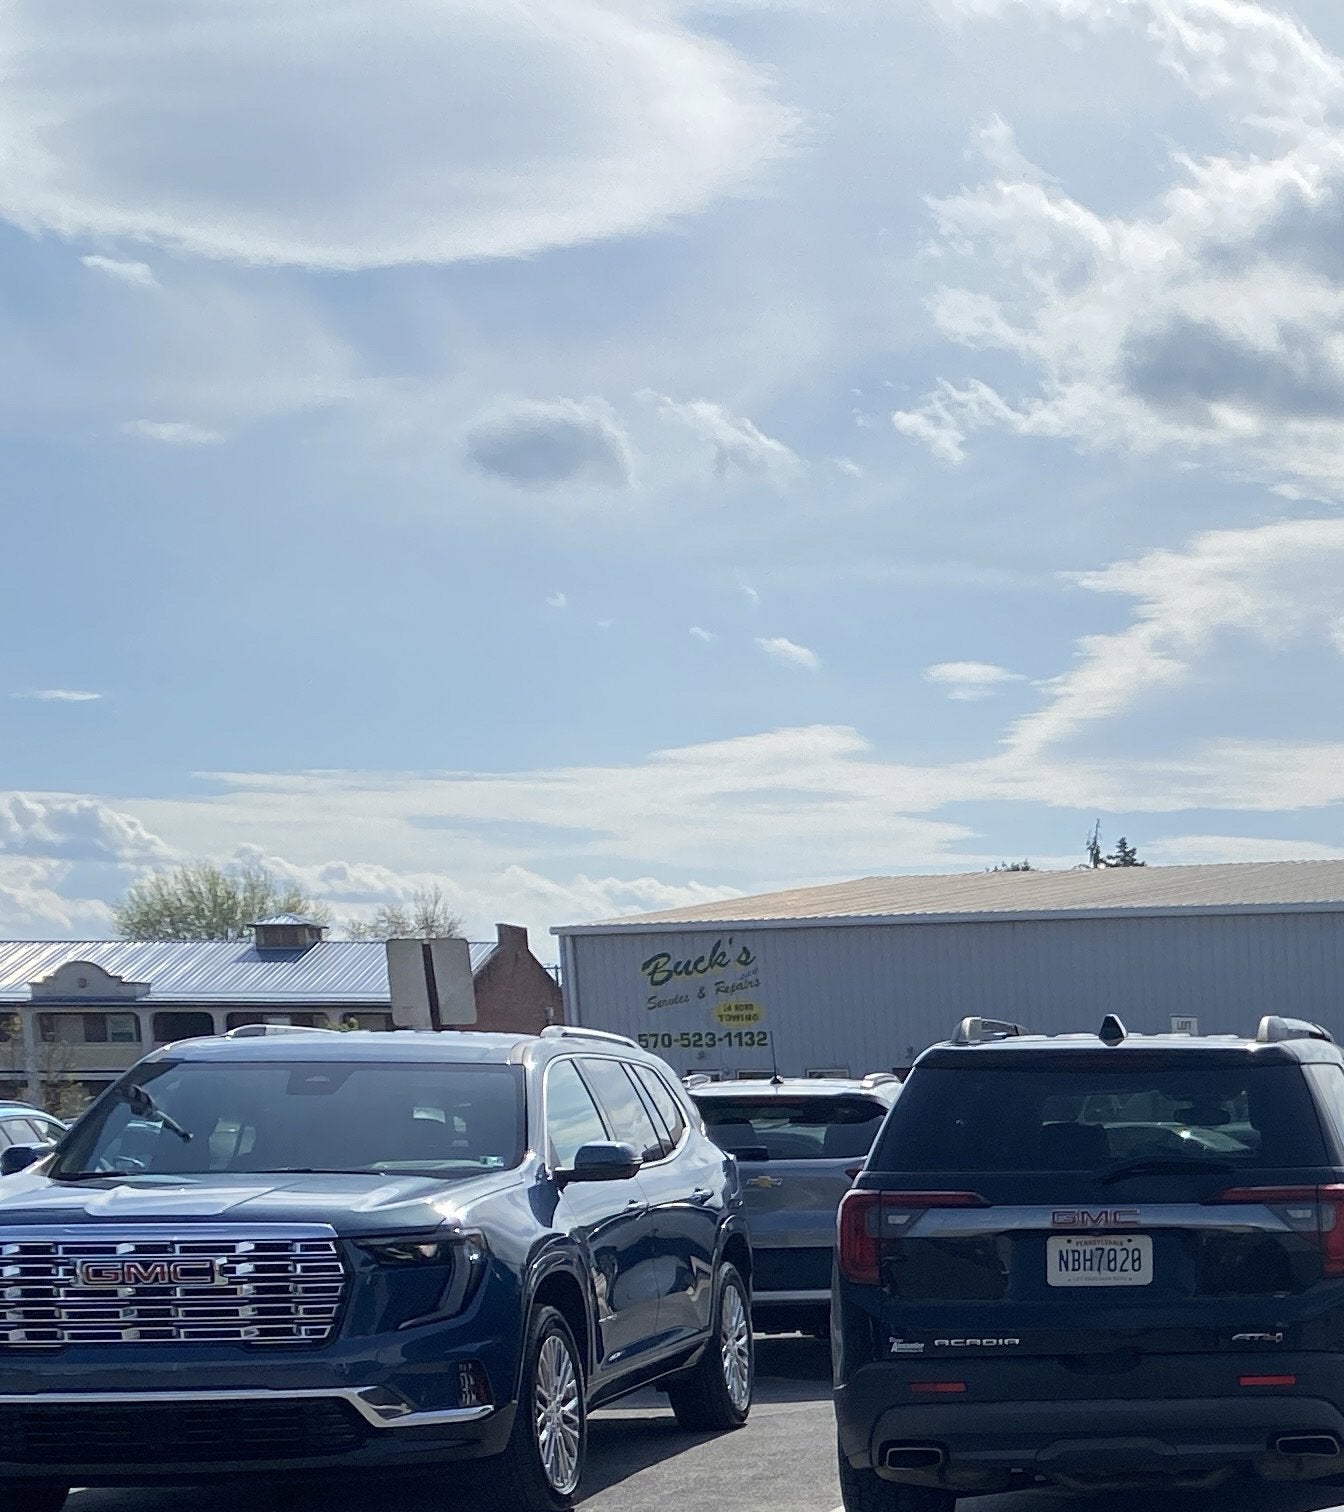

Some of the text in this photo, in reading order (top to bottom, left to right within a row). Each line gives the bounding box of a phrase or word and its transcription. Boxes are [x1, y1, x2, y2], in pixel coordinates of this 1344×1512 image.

[641, 937, 757, 987] Buck's
[714, 978, 761, 996] Repairs
[718, 1013, 759, 1022] TOWING
[637, 1031, 768, 1048] 570-523-1132
[1051, 1208, 1140, 1229] GMC
[1058, 1247, 1142, 1273] NBH7020
[82, 1261, 212, 1284] GMC
[934, 1338, 1020, 1347] ACADIA
